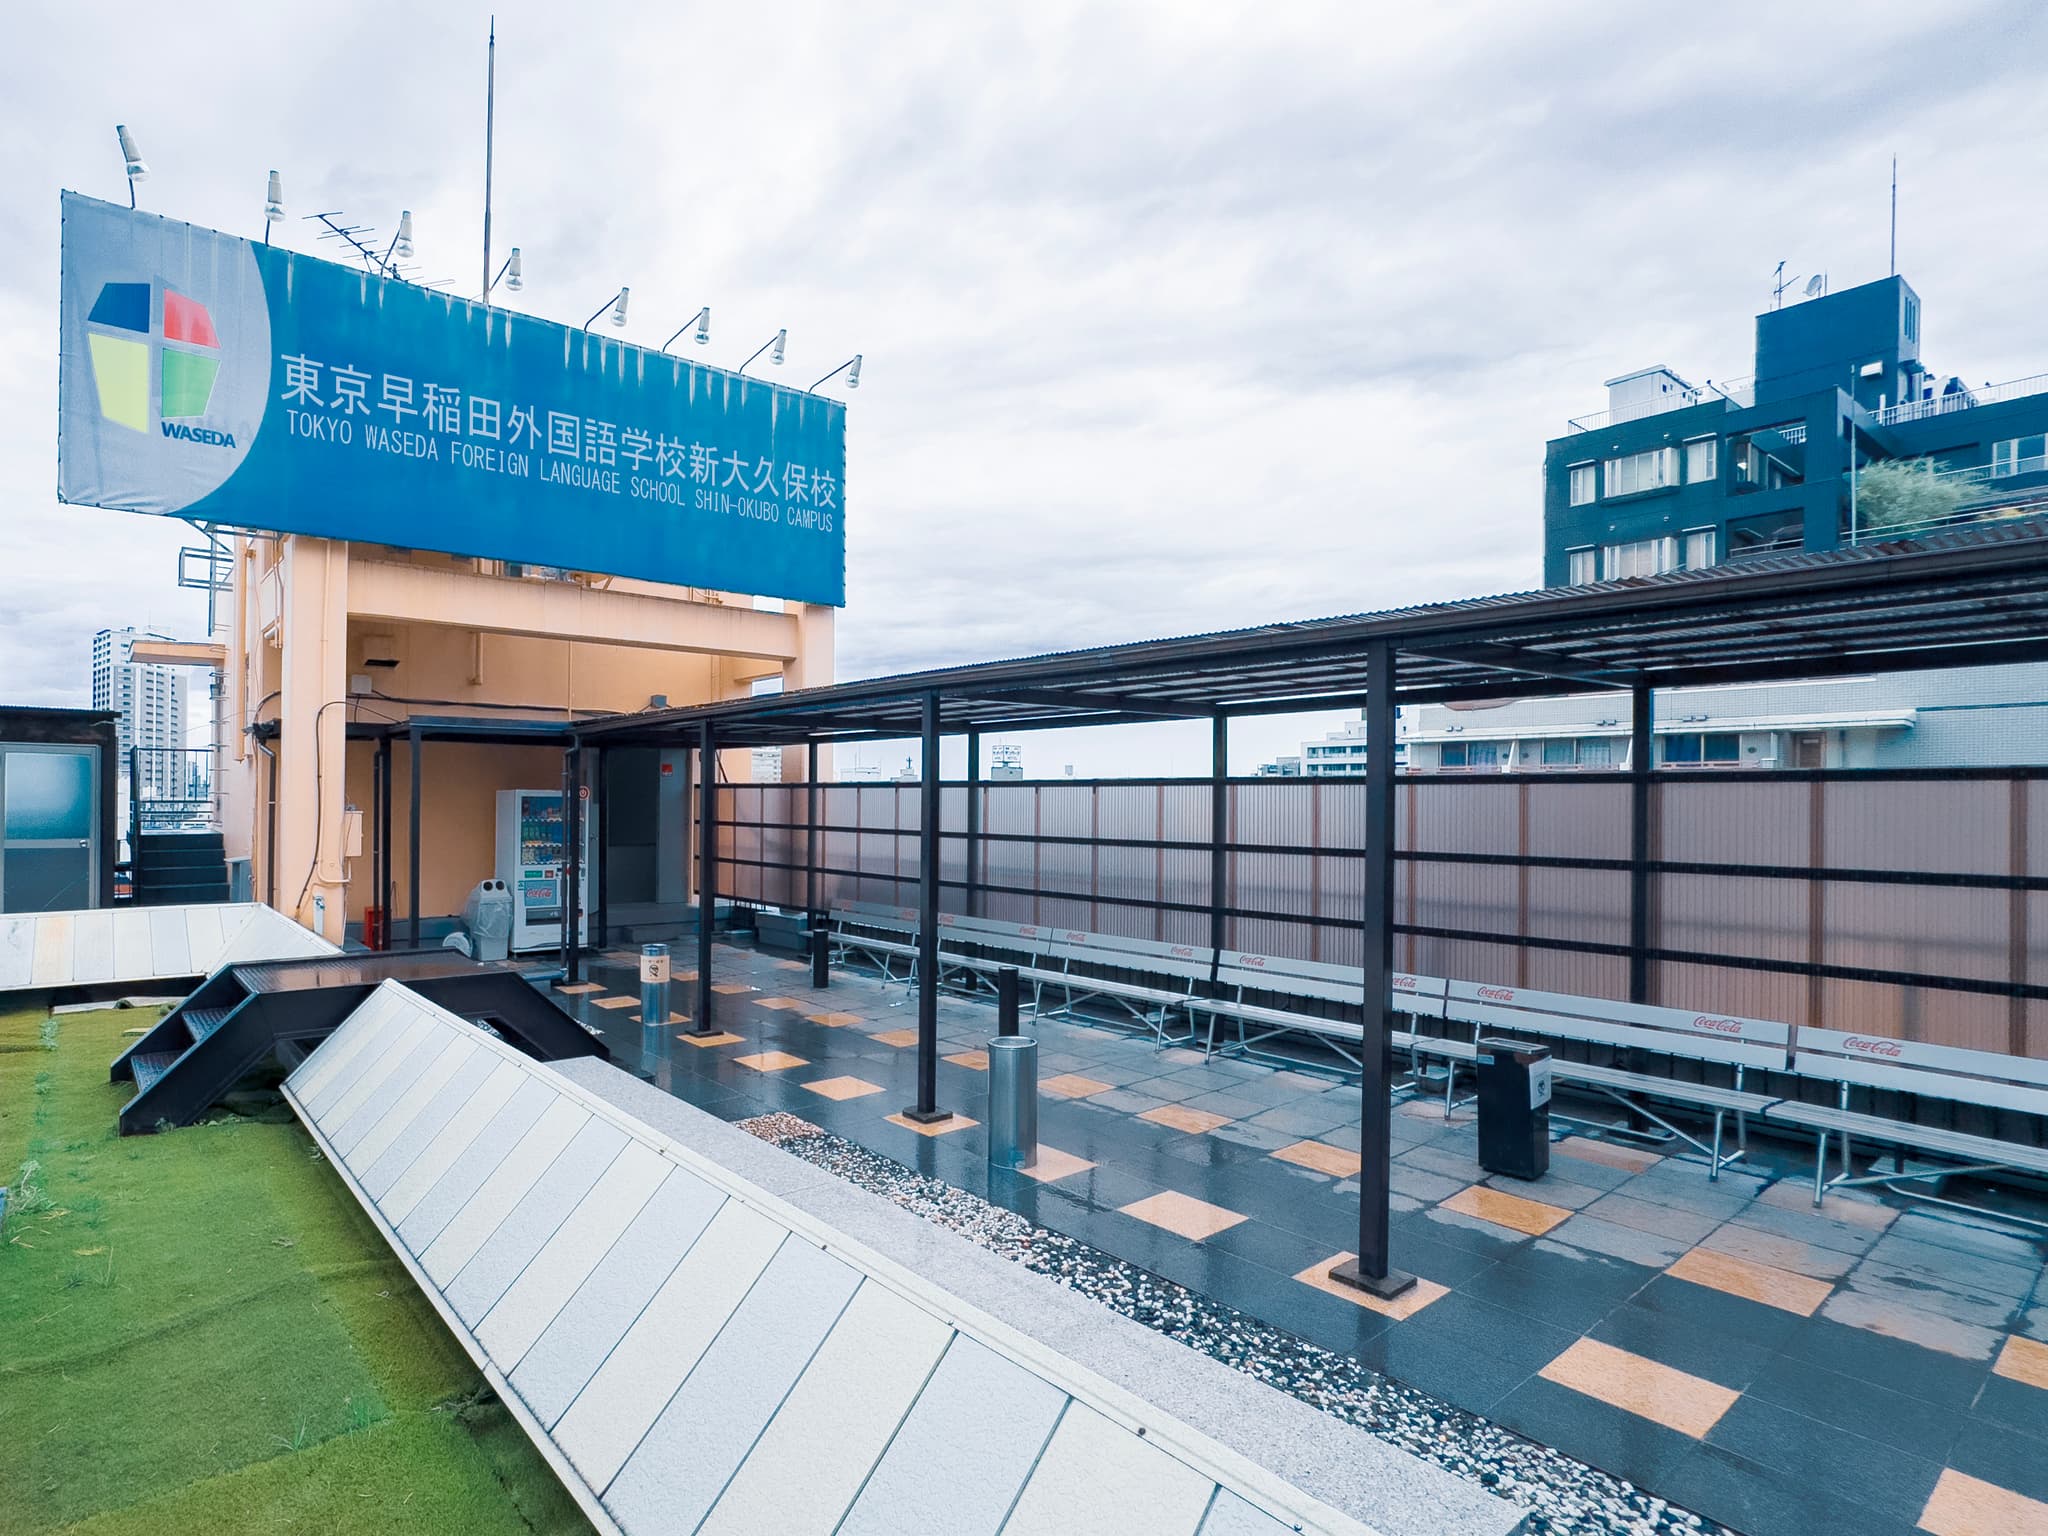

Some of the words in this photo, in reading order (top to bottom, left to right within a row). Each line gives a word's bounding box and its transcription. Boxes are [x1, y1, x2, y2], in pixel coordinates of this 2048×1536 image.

[161, 421, 236, 449] WASEDA
[281, 353, 837, 509] 東京早稲田外国語学校新大久保校
[287, 409, 353, 445] TOKYO
[365, 424, 439, 461] WASEDA
[451, 442, 529, 478] FOREIGN
[540, 460, 621, 494] LANGUAGE
[631, 477, 686, 506] SCHOOL
[695, 489, 780, 523] SHIN-OKUBO
[787, 506, 833, 532] CAMPUS
[1693, 1015, 1744, 1034] Coca-Cola
[1842, 1036, 1903, 1057] Coca-Cola
